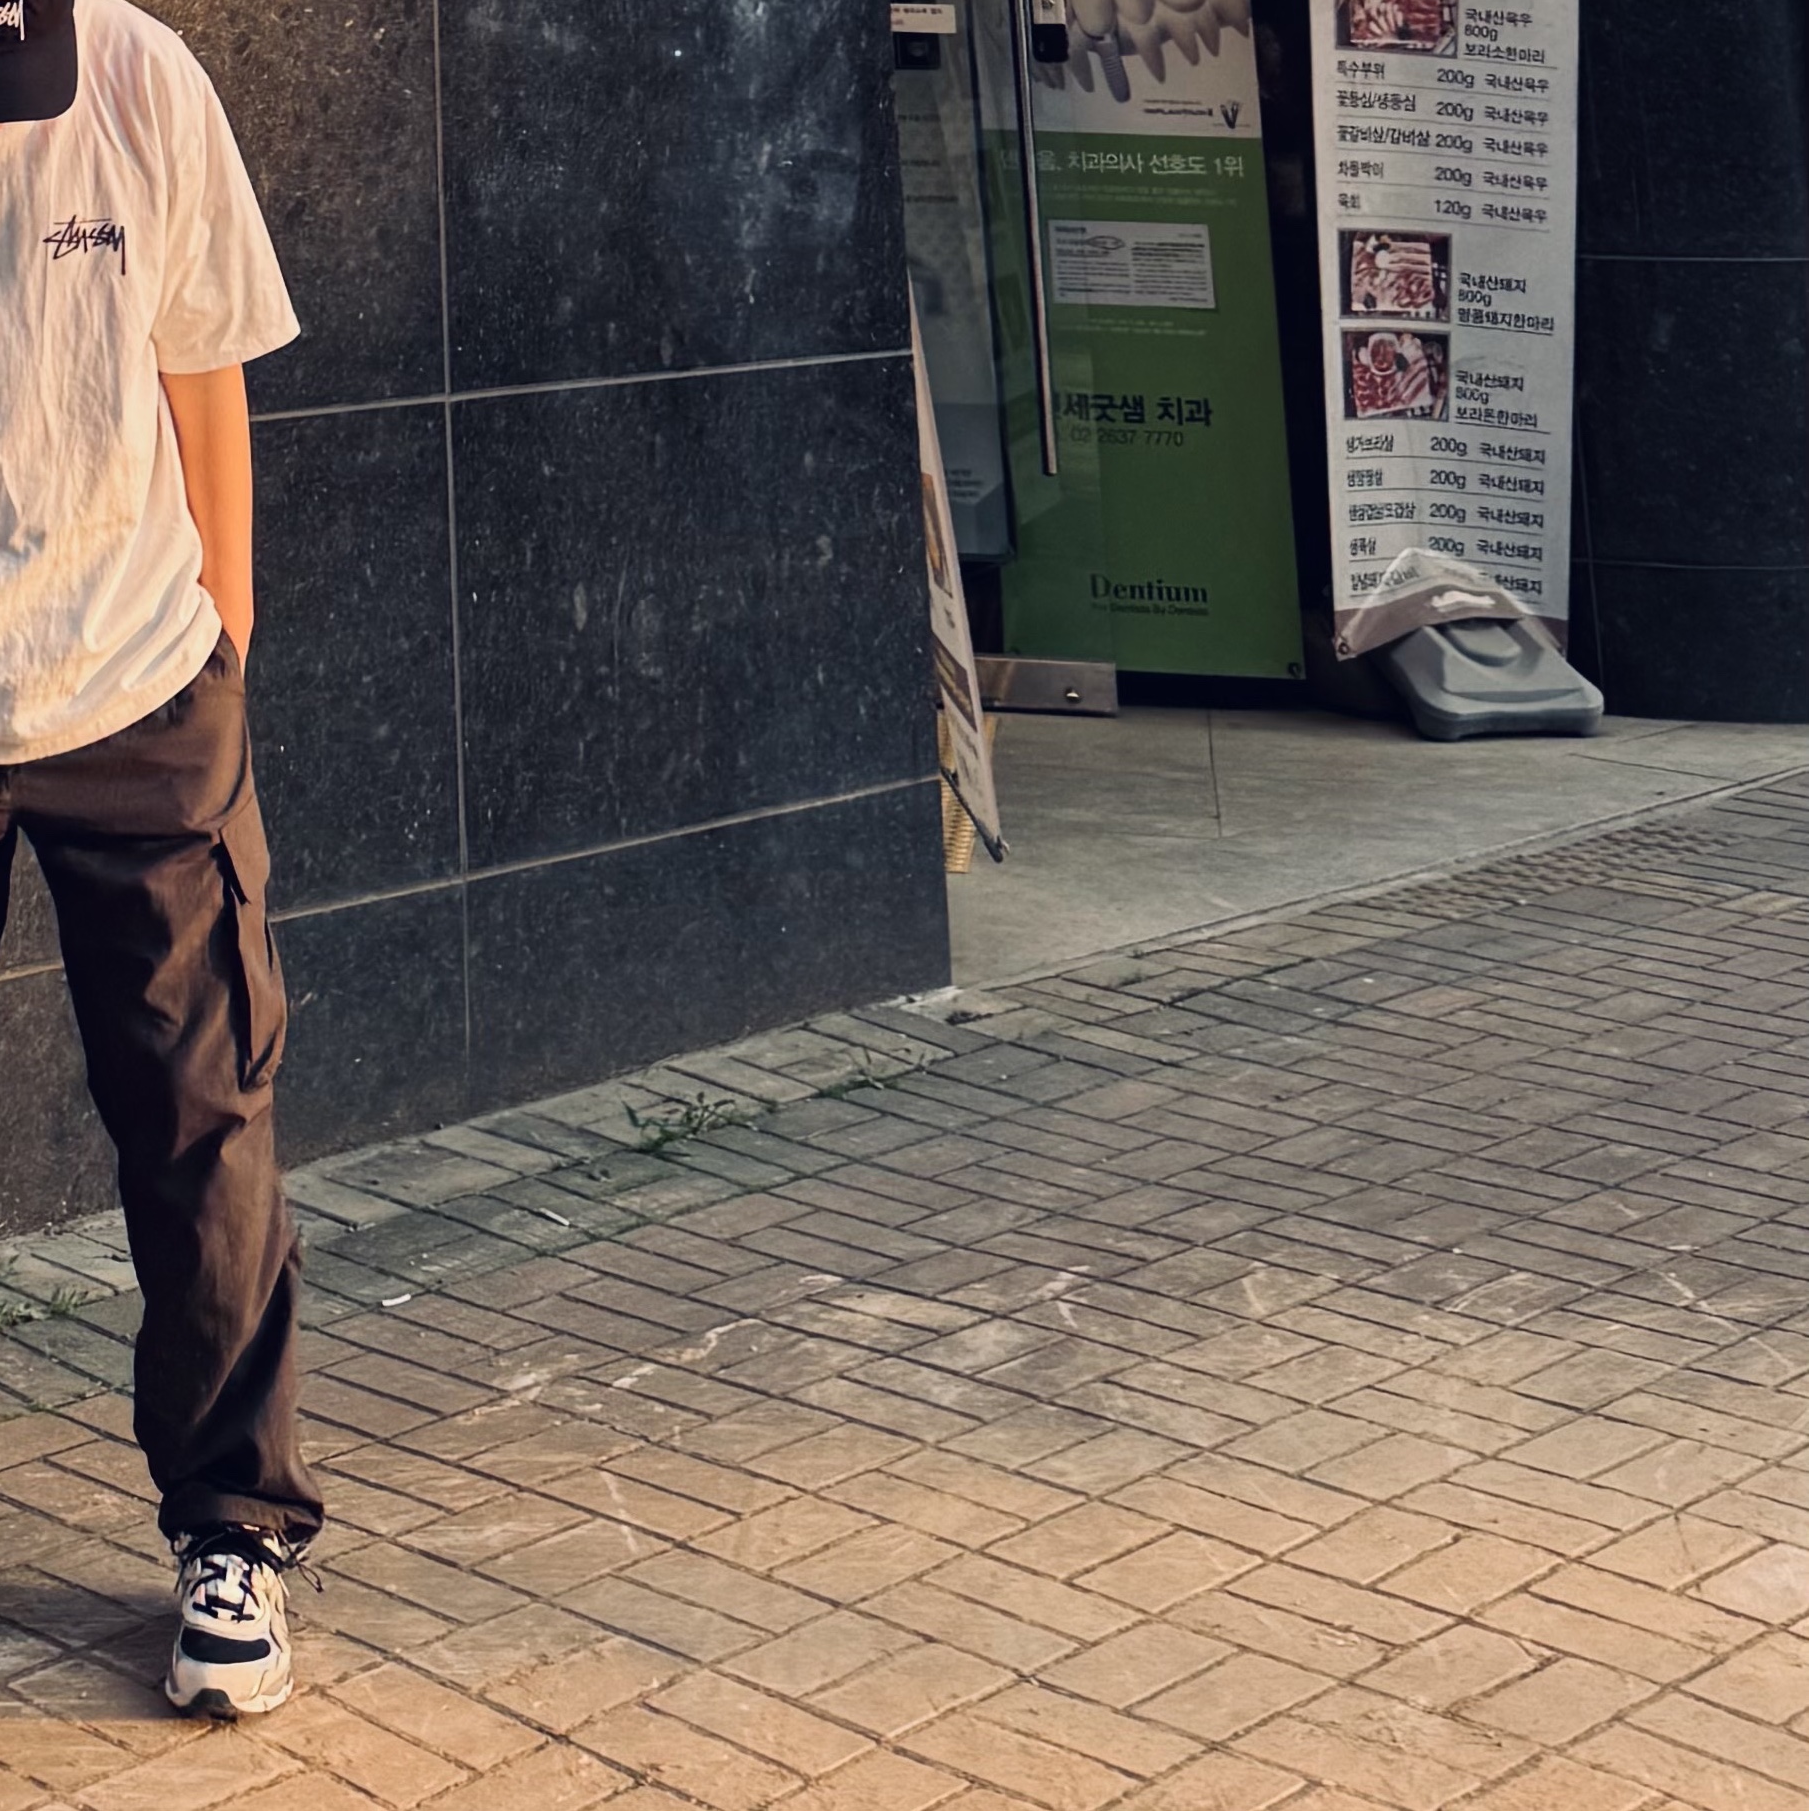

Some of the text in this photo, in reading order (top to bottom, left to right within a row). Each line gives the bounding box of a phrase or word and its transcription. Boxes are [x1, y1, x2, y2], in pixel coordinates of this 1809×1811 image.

[1436, 68, 1475, 89] 200g
[1435, 101, 1474, 122] 200g
[1434, 133, 1473, 154] 200g
[1068, 151, 1145, 174] 치과의사
[1148, 153, 1208, 176] 선호도
[1212, 155, 1246, 178] 1위
[1434, 166, 1473, 188] 200g
[1054, 392, 1214, 427] 세굿샘 치과
[1143, 430, 1185, 448] 7770
[1429, 436, 1469, 458] 200g
[1429, 469, 1467, 491] 200g
[1429, 502, 1467, 524] 200g
[1427, 536, 1466, 558] 200g
[1089, 572, 1209, 604] Dentium
